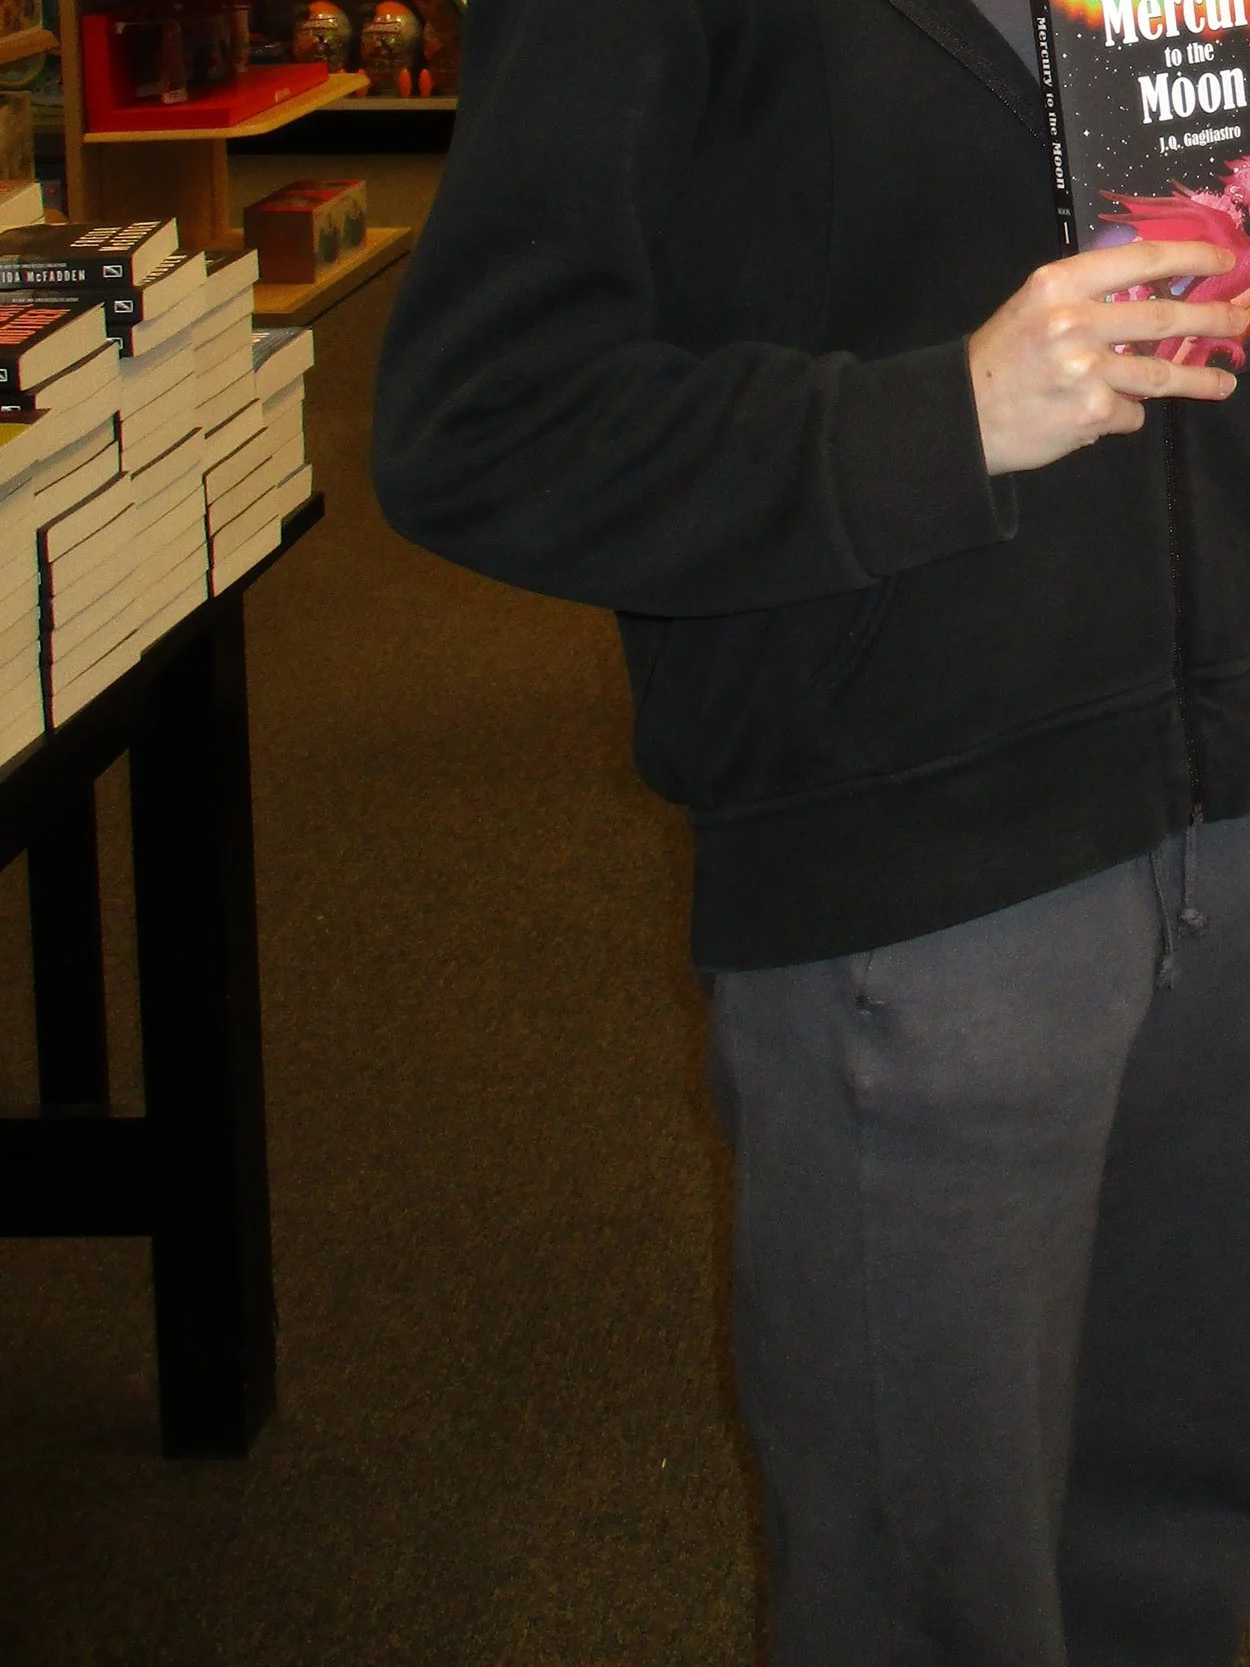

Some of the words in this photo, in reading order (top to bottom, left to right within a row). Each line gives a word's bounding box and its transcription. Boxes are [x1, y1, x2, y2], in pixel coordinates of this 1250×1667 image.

[1036, 17, 1053, 88] Mercury
[1165, 47, 1183, 68] to
[1186, 42, 1215, 64] the
[1046, 92, 1055, 108] to
[1137, 67, 1247, 124] Moon
[1048, 111, 1059, 135] the
[1159, 136, 1184, 154] J.Q.
[1184, 125, 1242, 148] Gagliastro
[1052, 142, 1065, 189] Moon
[27, 269, 86, 283] McFADDEN
